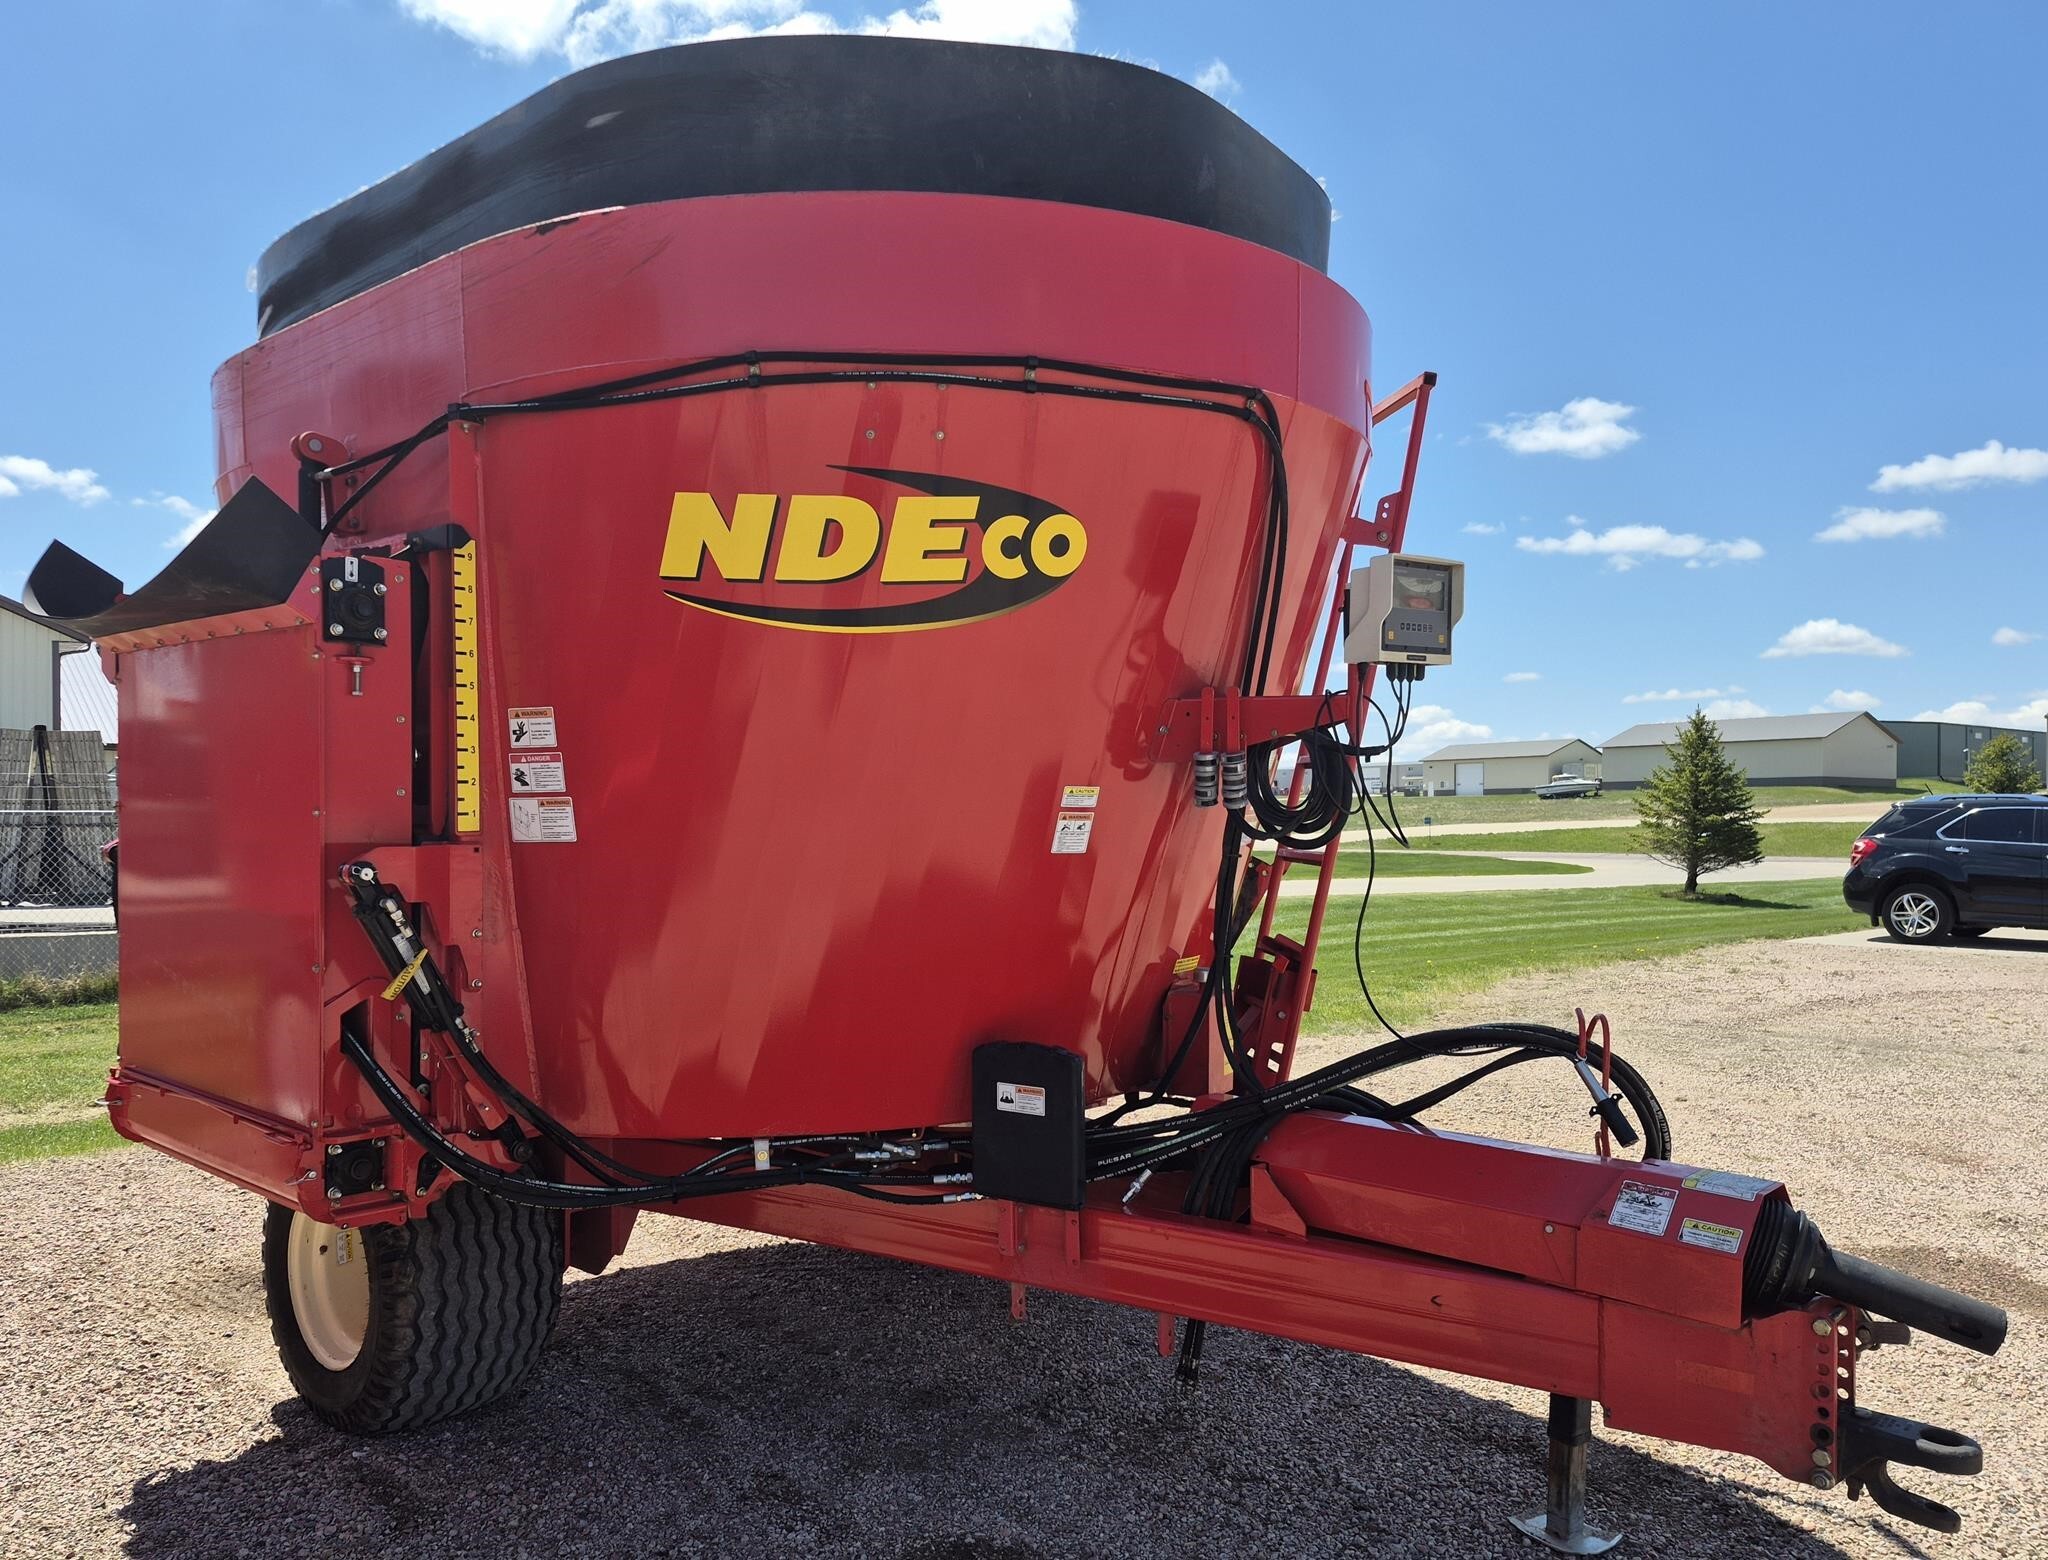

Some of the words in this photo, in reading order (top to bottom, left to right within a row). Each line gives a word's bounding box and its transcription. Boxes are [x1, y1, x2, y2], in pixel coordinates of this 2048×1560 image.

[467, 552, 473, 561] 9
[467, 584, 473, 594] 8
[468, 617, 474, 626] 7
[468, 649, 475, 658] 6
[469, 681, 475, 690] 5
[470, 714, 475, 722] 4
[470, 745, 476, 754] 3
[471, 778, 477, 786] 2
[1097, 1153, 1133, 1167] PULSAR
[1701, 1224, 1735, 1236] CAUTION
